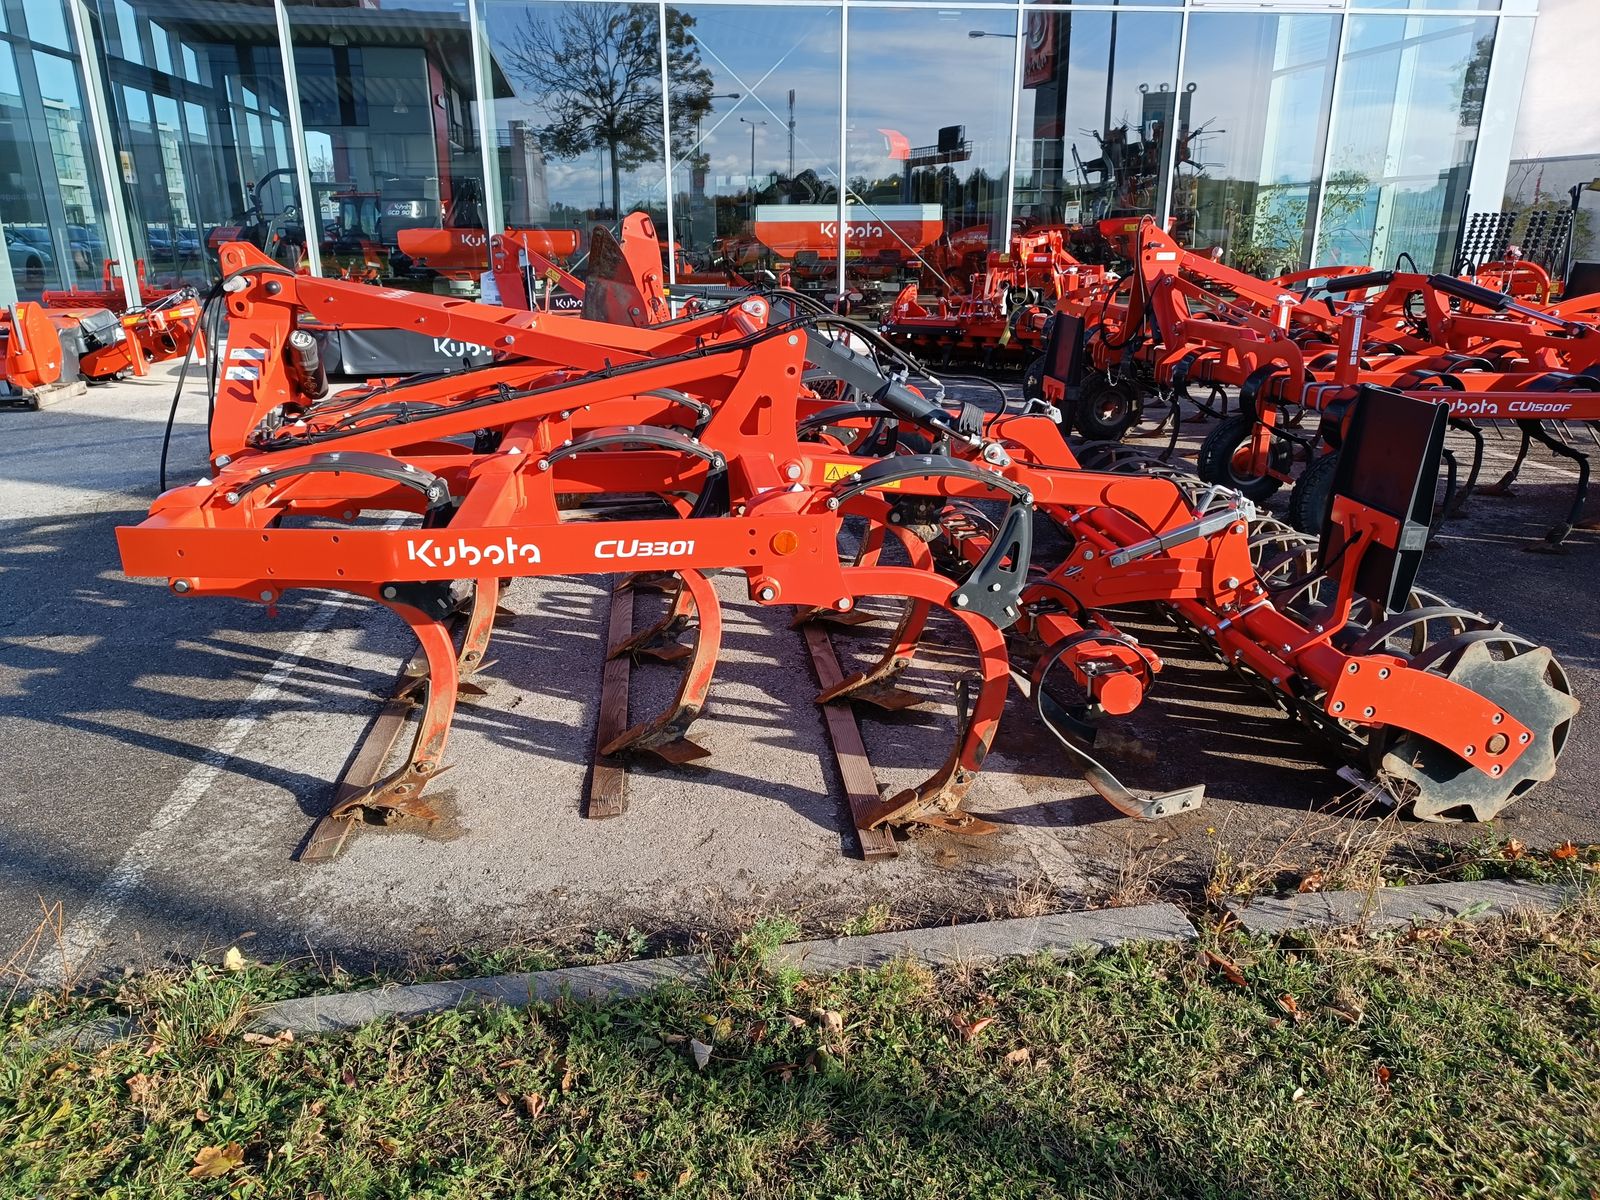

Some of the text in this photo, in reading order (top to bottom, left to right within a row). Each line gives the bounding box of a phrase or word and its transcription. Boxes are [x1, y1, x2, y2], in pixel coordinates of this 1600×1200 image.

[1508, 400, 1573, 412] CU1500F
[406, 536, 695, 568] Kubota CU3301
